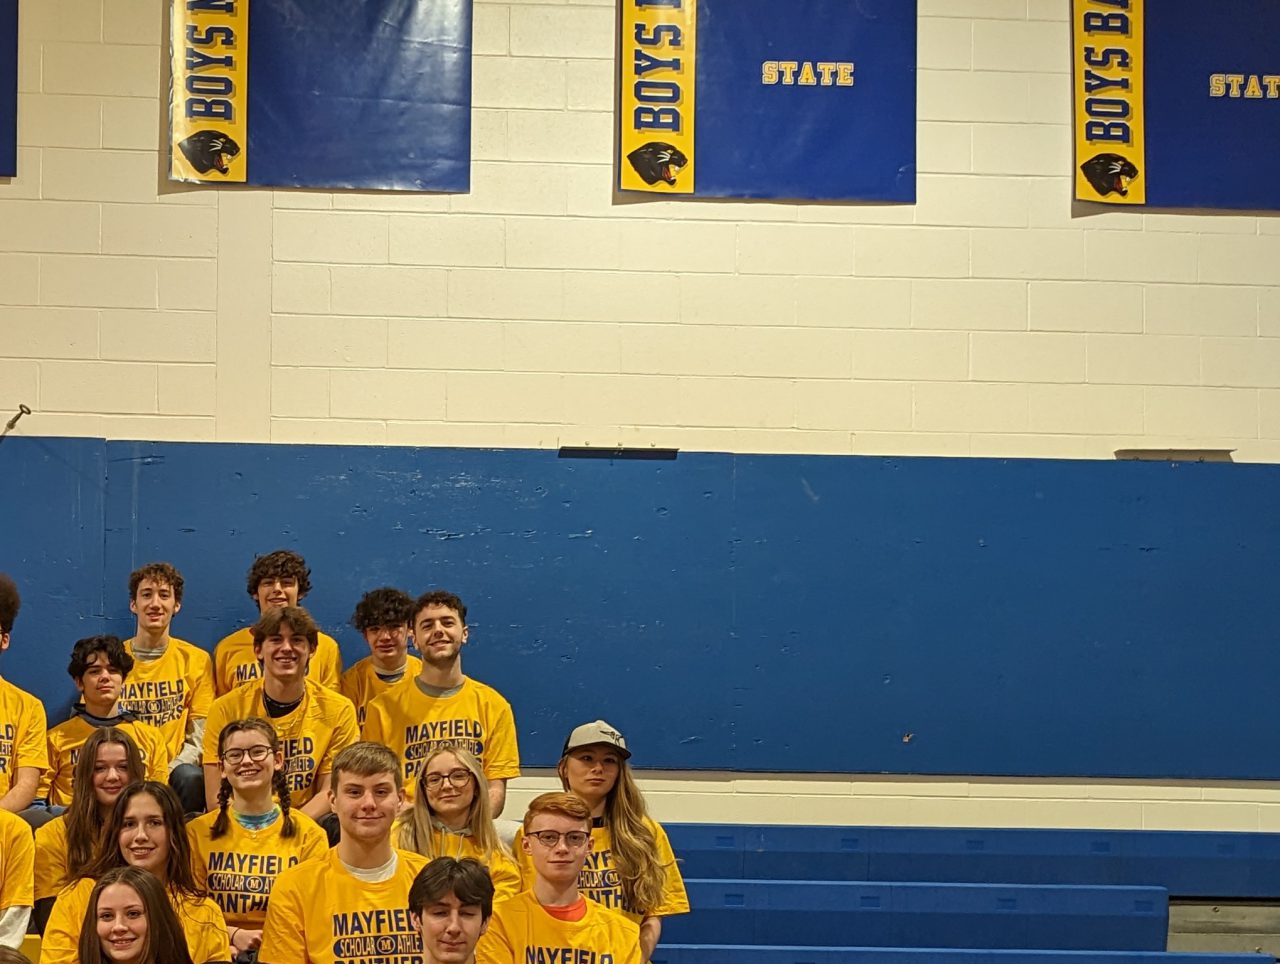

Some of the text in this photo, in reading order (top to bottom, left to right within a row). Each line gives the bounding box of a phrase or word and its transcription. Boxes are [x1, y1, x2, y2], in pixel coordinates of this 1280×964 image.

[185, 24, 234, 121] BOYS
[634, 23, 682, 132] BOYS
[761, 61, 855, 87] STATE
[1084, 47, 1130, 144] BOYS
[405, 719, 483, 744] MAYFIELD
[212, 874, 245, 890] SCHOLAR
[333, 909, 414, 937] MAYFIEL
[340, 939, 376, 956] SCHOLAR
[398, 934, 420, 954] ATHLE
